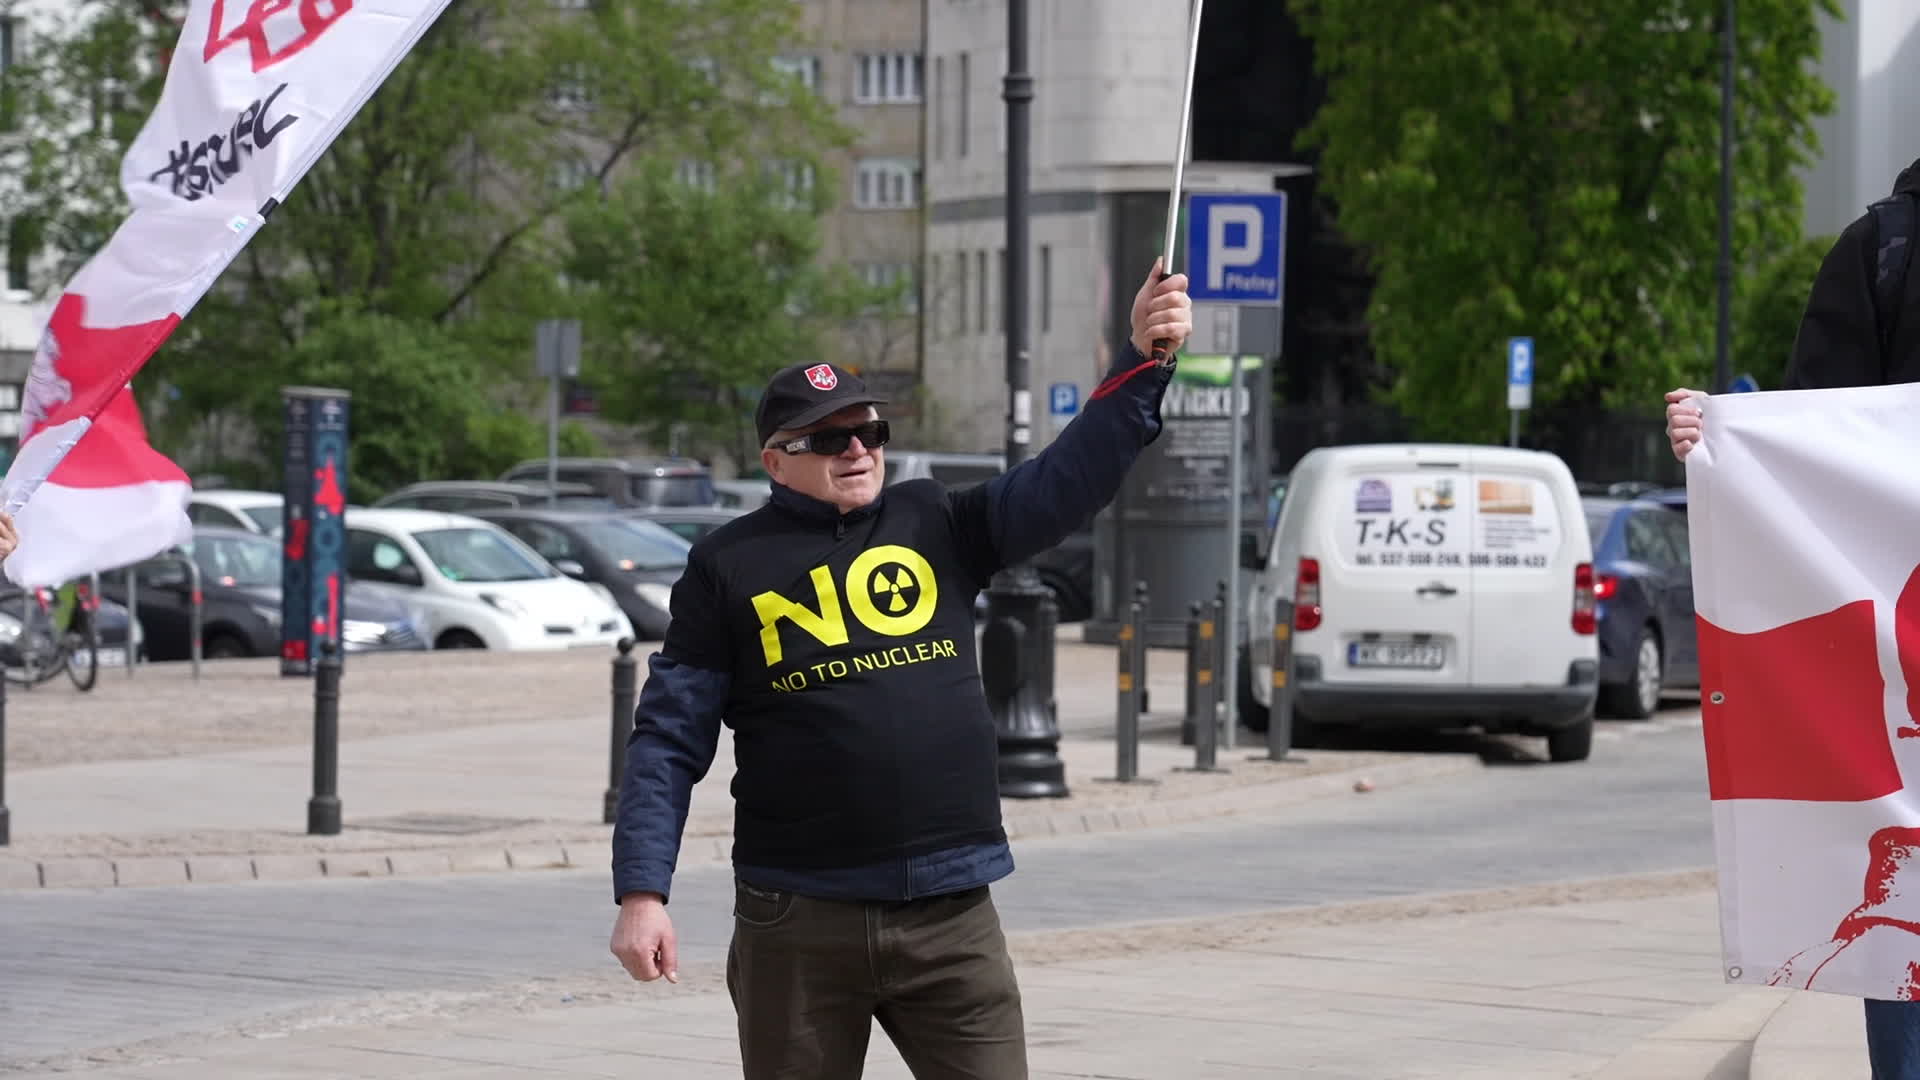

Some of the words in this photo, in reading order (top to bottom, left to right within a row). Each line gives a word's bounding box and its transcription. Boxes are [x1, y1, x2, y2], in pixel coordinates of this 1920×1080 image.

[1208, 204, 1264, 290] P
[1055, 386, 1076, 412] P
[1356, 519, 1447, 546] T-K-S
[751, 544, 938, 667] NO
[772, 671, 807, 693] NO
[811, 660, 848, 681] TO
[853, 639, 958, 673] NUCLEAR
